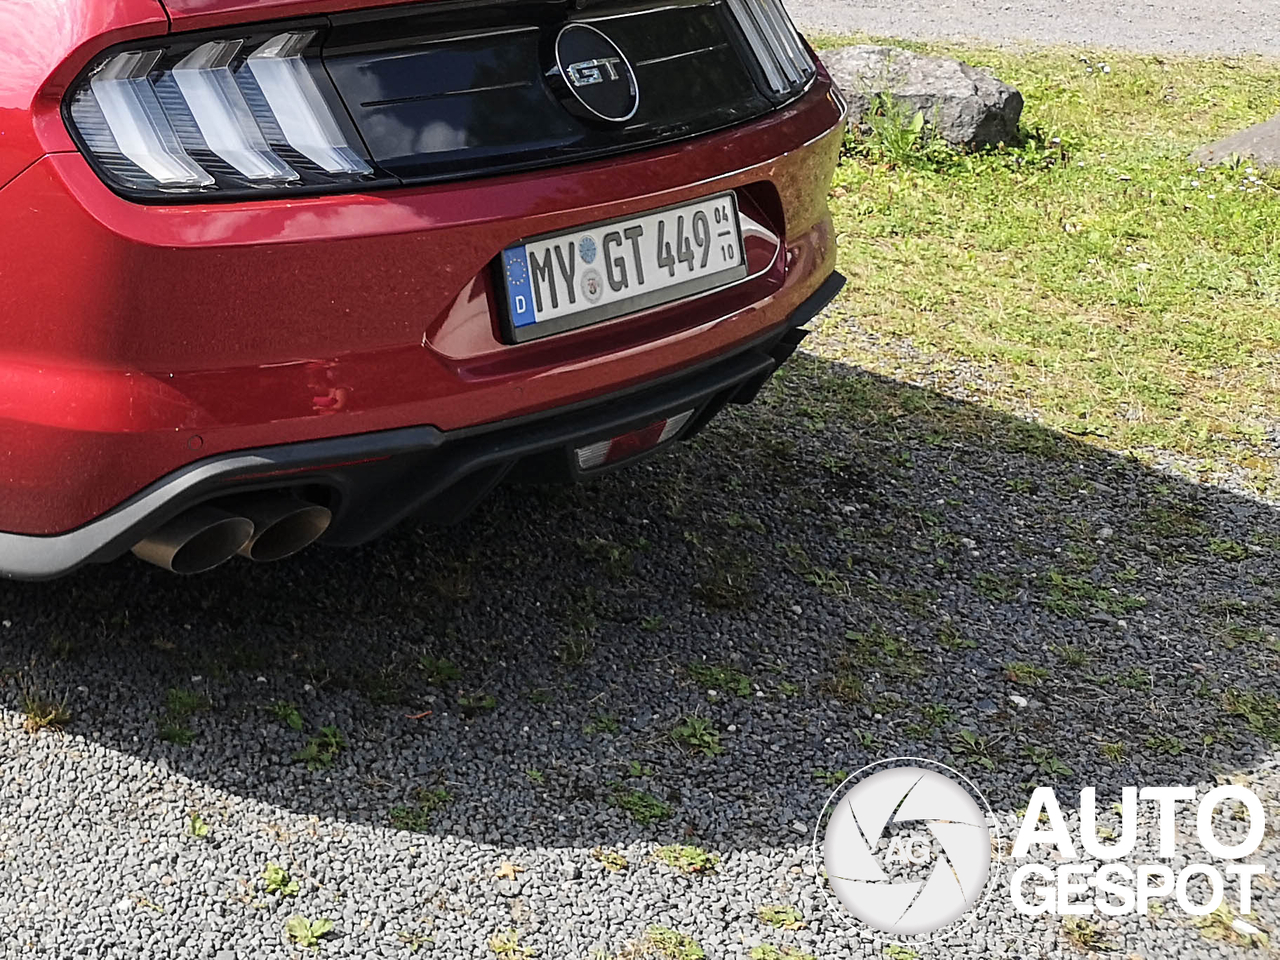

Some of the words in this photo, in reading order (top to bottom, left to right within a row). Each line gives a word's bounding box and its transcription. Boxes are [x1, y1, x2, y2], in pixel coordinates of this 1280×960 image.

[569, 57, 620, 86] GT
[714, 205, 729, 223] 04
[529, 241, 576, 313] MY
[602, 224, 645, 292] GT
[657, 210, 711, 277] 449
[721, 243, 734, 262] 10
[516, 295, 526, 314] D
